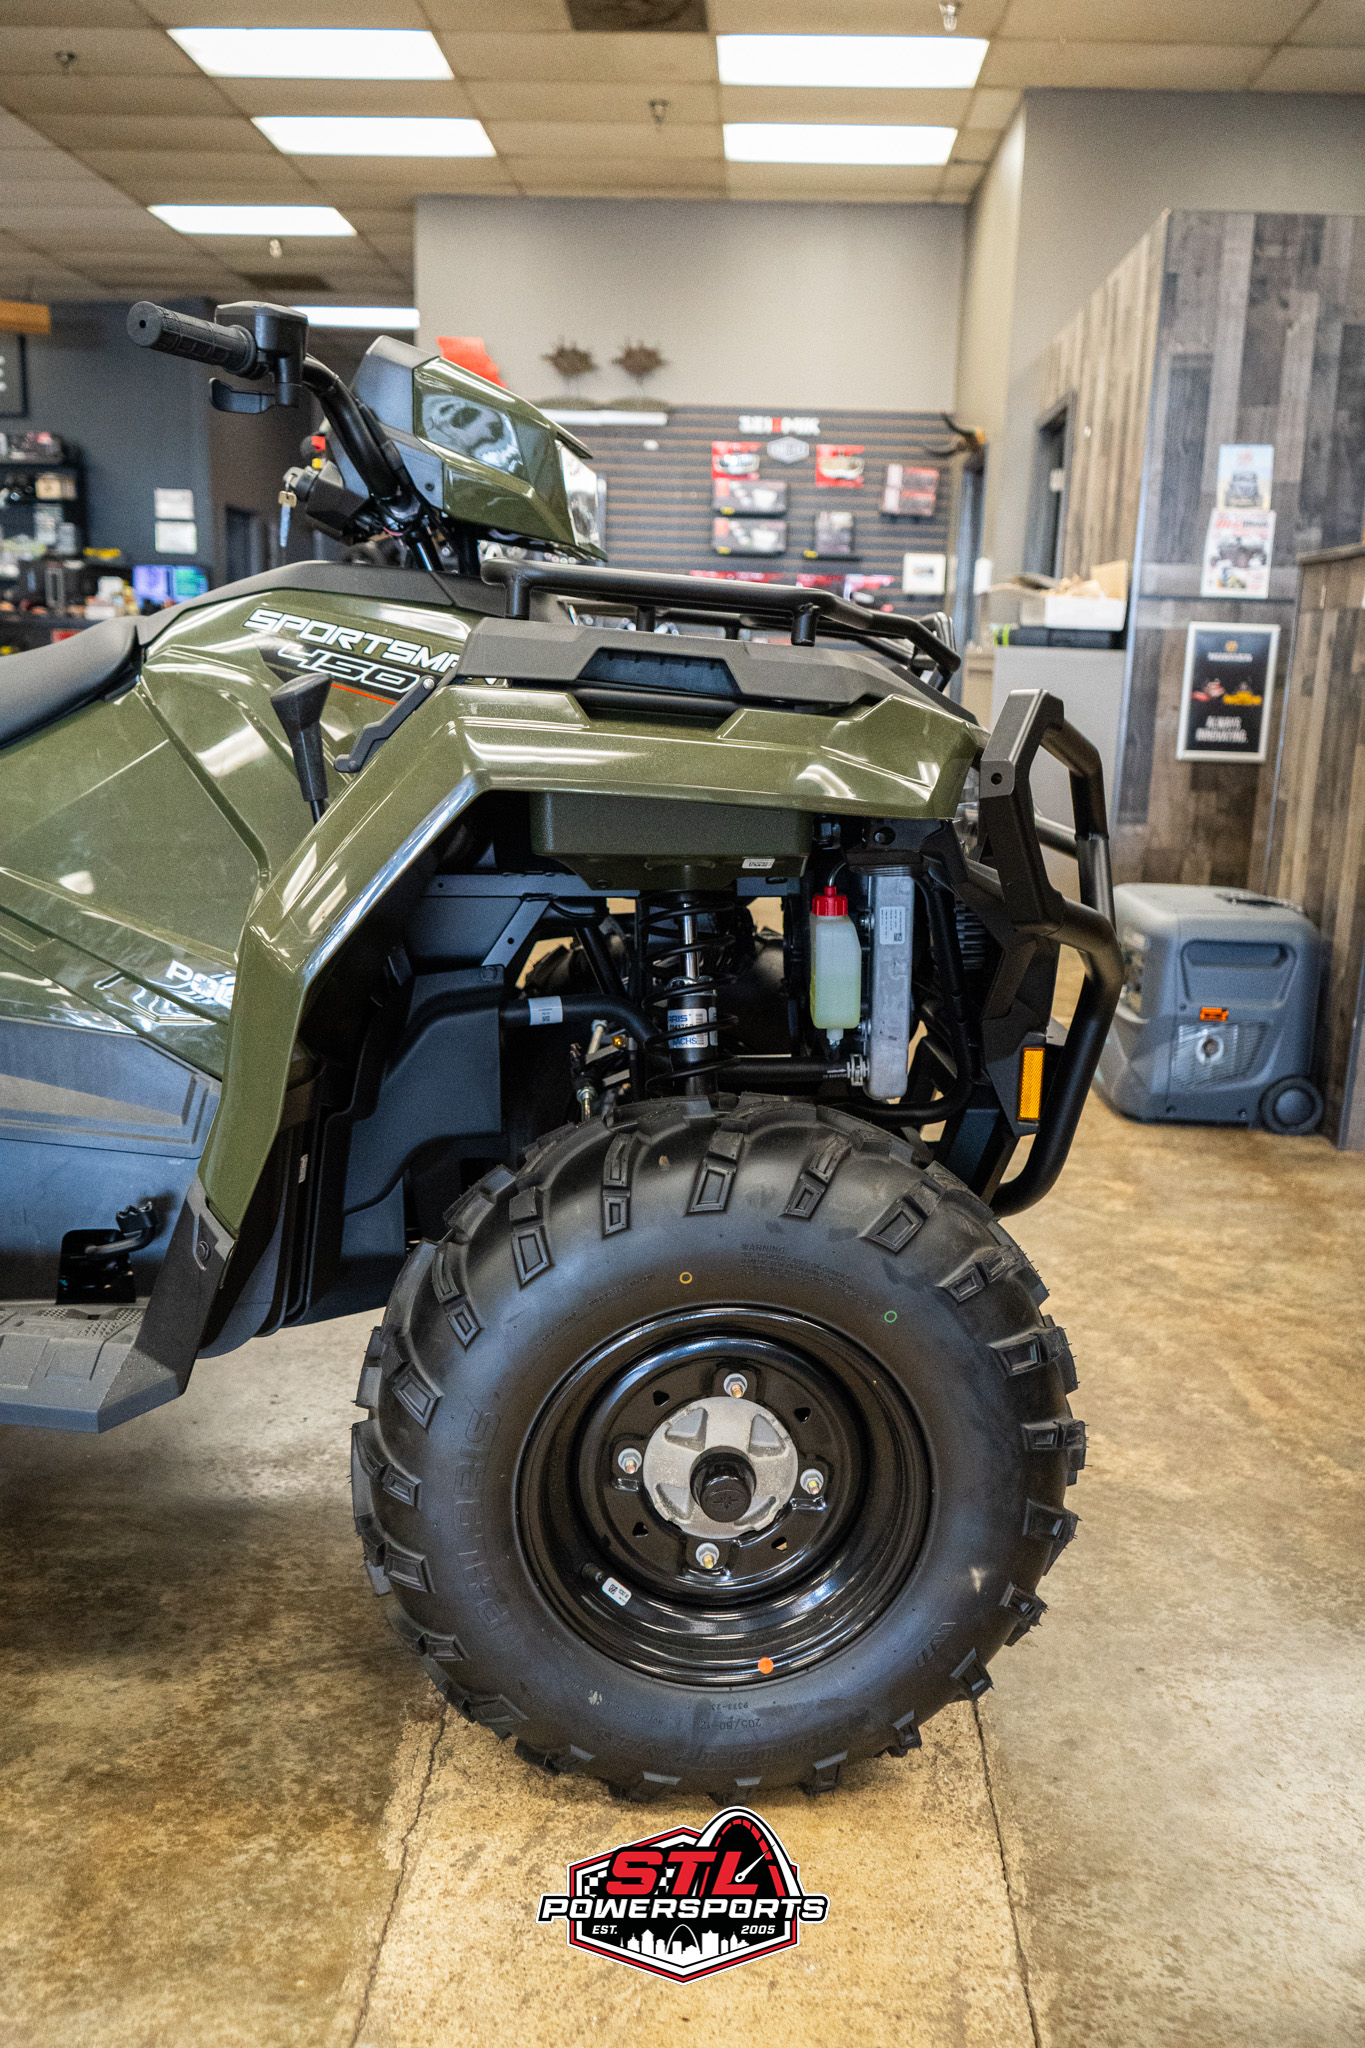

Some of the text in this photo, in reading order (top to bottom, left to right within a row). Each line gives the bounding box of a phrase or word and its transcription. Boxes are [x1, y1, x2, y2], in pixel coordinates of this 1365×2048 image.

[243, 608, 460, 673] SPORTSMA
[277, 642, 420, 694] 450
[672, 1036, 697, 1046] SACHS
